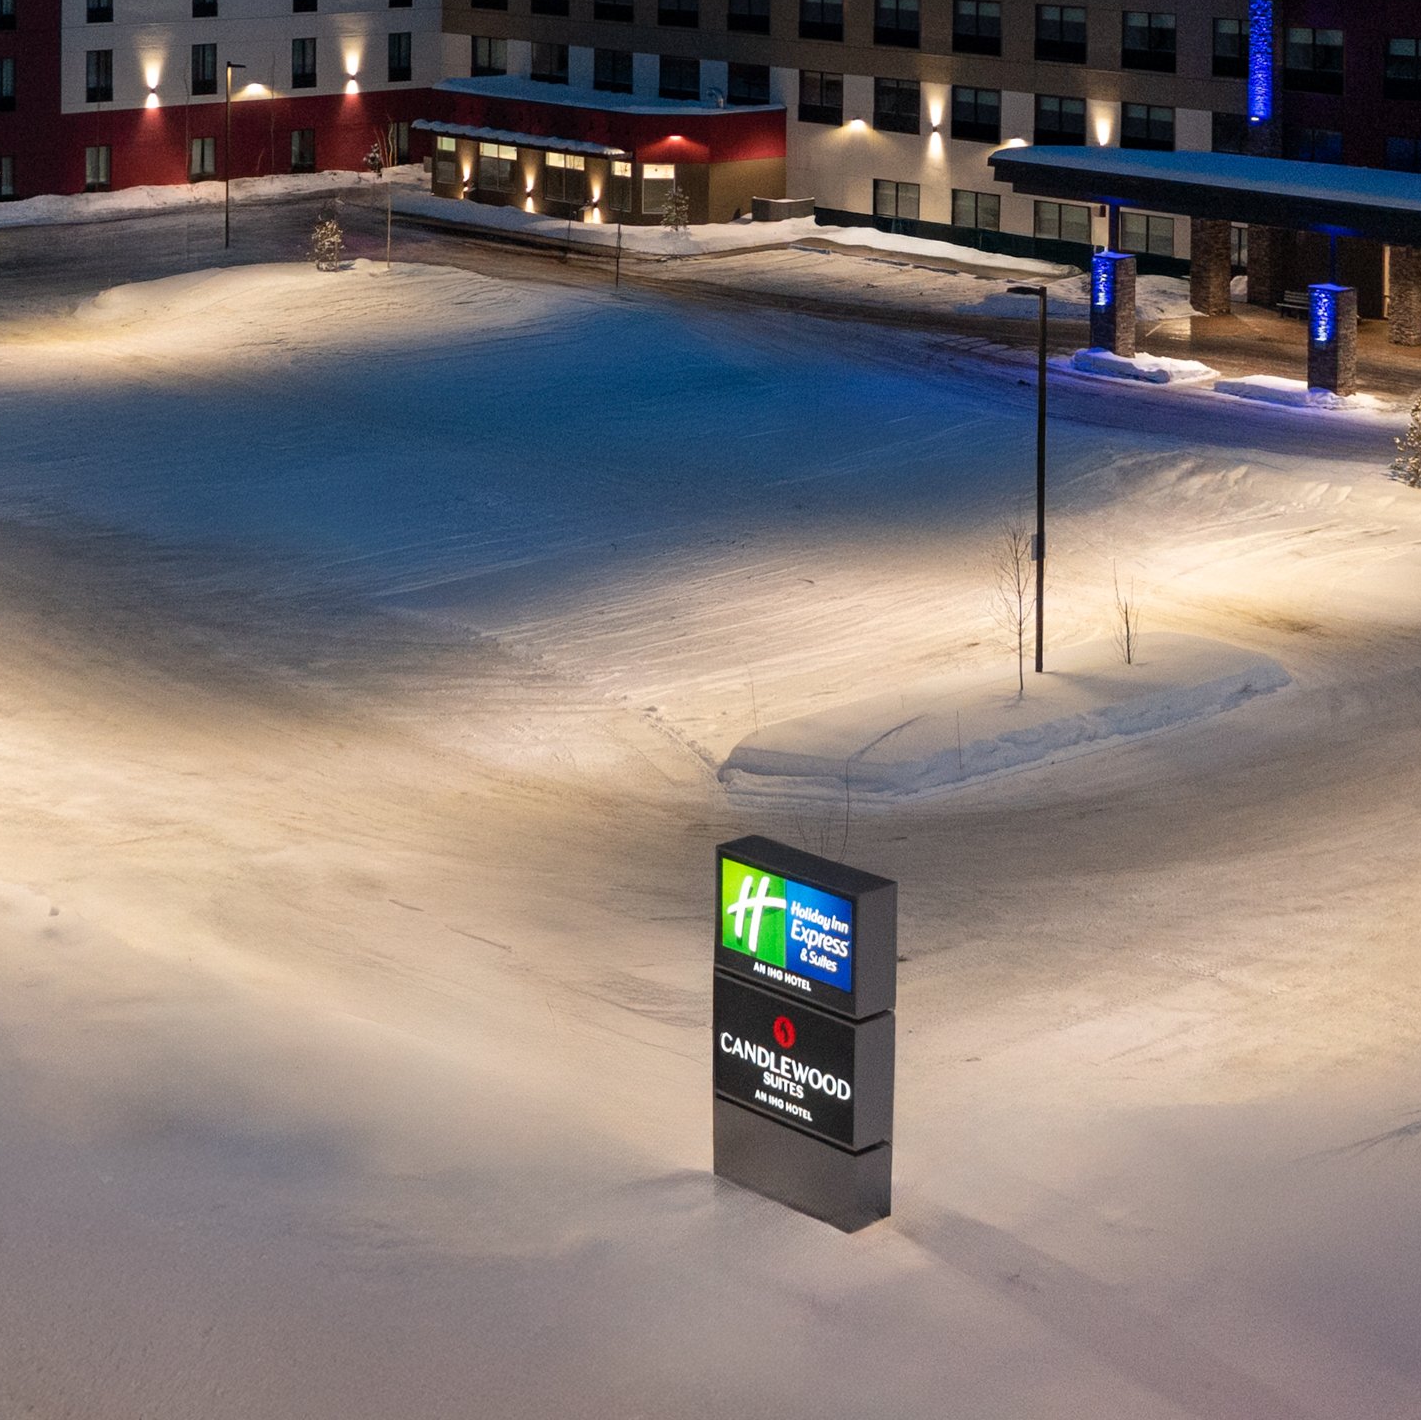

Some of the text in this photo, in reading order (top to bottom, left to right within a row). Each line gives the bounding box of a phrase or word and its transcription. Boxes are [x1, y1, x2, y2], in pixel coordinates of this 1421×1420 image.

[791, 901, 849, 935] Holiday Inn
[790, 919, 849, 958] Express
[753, 961, 812, 992] AN IHG HOTEL
[799, 948, 838, 973] & Suites
[720, 1031, 851, 1101] CANDLEWOOD
[763, 1071, 805, 1100] SUITES
[754, 1089, 813, 1122] AN IHG HOTEL
